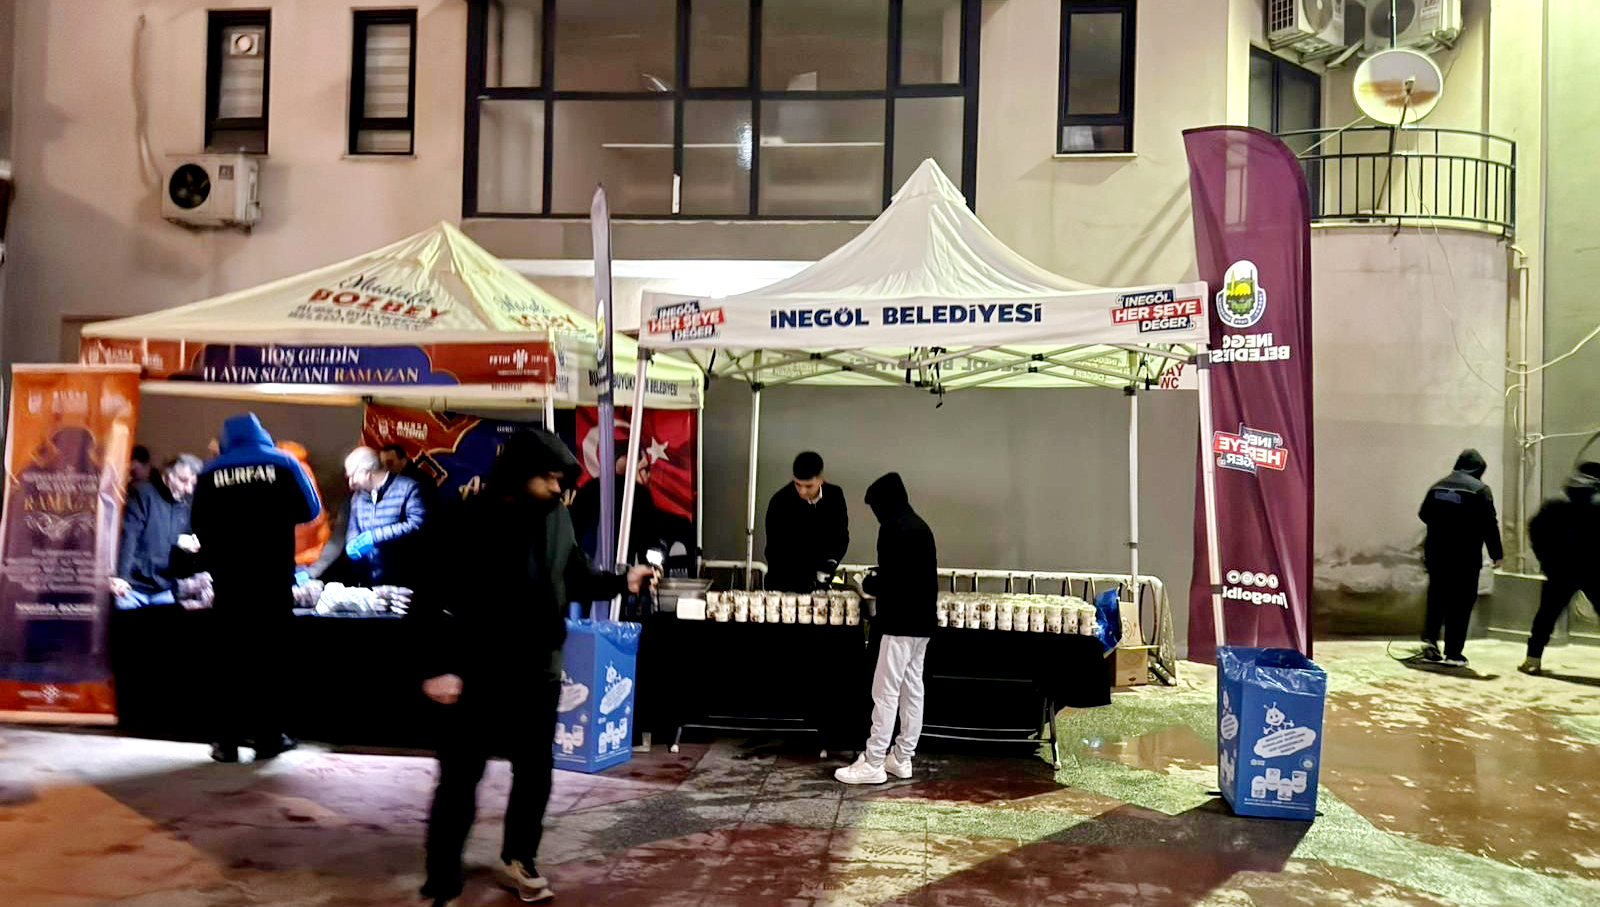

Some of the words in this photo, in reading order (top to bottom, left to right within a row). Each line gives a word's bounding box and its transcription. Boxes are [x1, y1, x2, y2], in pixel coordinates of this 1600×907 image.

[308, 288, 450, 319] BOZBEY
[1115, 307, 1150, 322] HER
[1153, 301, 1197, 319] ŞEYE
[652, 316, 681, 332] HER
[770, 308, 869, 329] İNEGÖL
[882, 303, 1042, 325] BELEDİYESİ
[1141, 316, 1188, 332] DEĞER
[261, 347, 295, 367] HOŞ
[298, 345, 360, 365] GELDİN
[221, 366, 258, 382] AYIN
[260, 367, 329, 383] SULTANI
[335, 368, 419, 383] RAMAZAN
